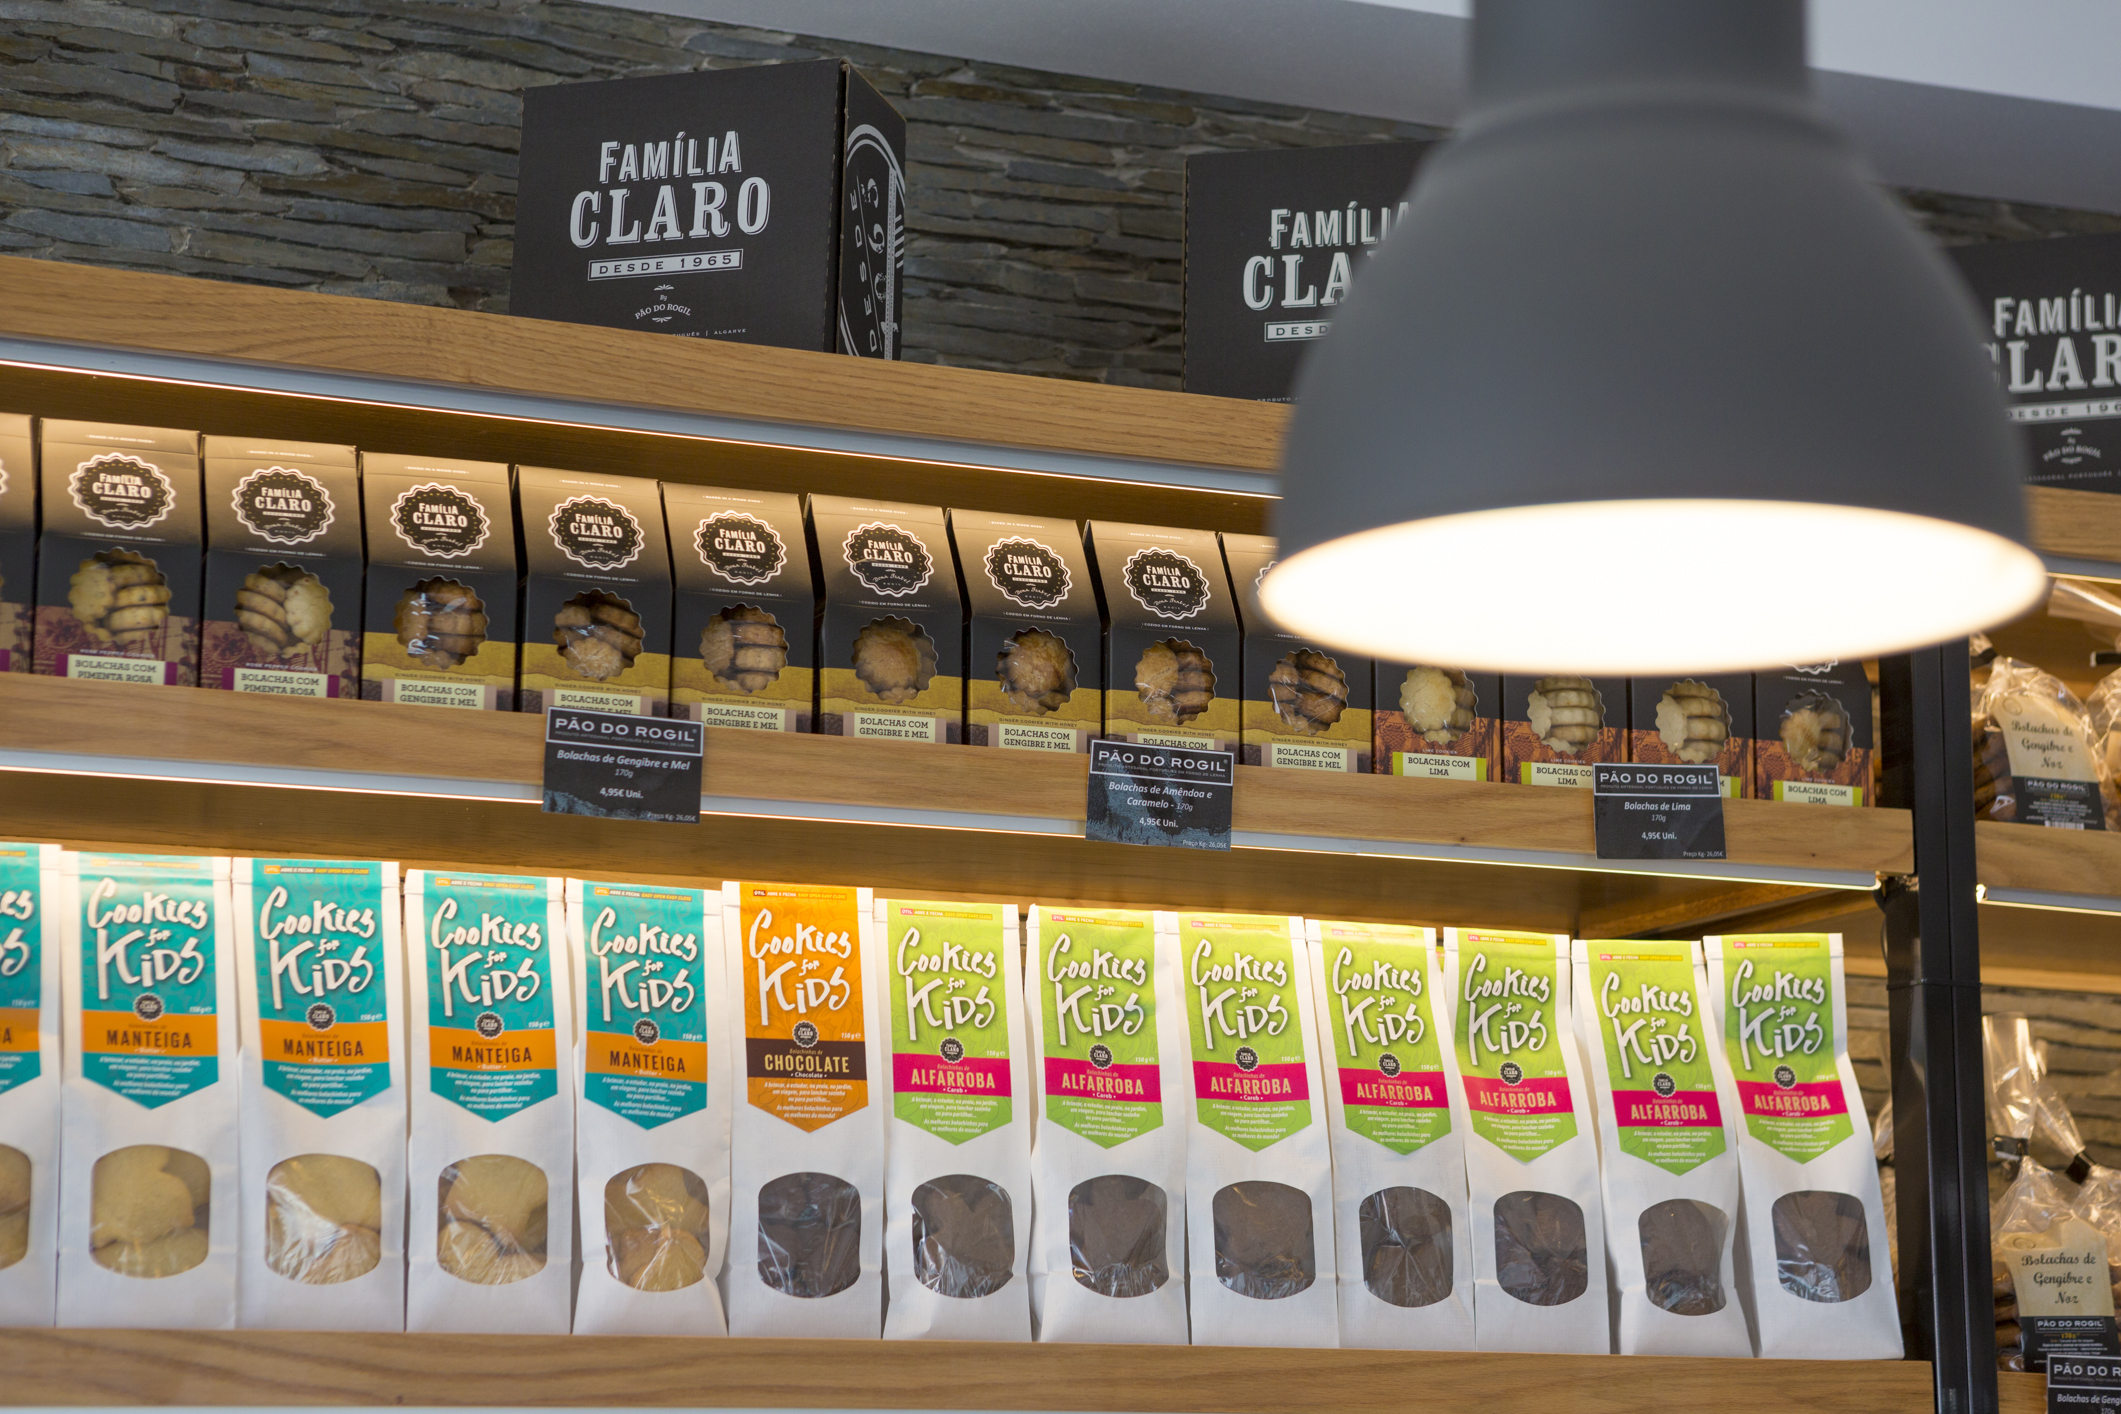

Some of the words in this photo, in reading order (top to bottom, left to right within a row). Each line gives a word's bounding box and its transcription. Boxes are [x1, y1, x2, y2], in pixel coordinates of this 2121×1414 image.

[599, 131, 743, 184] FAMÍLIA
[570, 176, 771, 248] CLARO
[599, 261, 664, 275] DESDE
[680, 255, 733, 269] 1965
[1243, 252, 1376, 310] CLA
[635, 307, 652, 320] PÃO
[653, 304, 665, 312] DO
[667, 304, 691, 316] ROGIL
[1994, 287, 2121, 338] FAMÍLI
[1275, 325, 1329, 337] DESD
[262, 487, 303, 499] FAMÍLIA
[255, 497, 311, 512] CLARO
[720, 528, 757, 540] FAMÍLIA
[714, 538, 766, 554] CLARO
[1007, 554, 1043, 566] FAMÍLIA
[1003, 563, 1052, 578] CLARO
[1146, 565, 1181, 577] FAMÍLIA
[1142, 574, 1190, 589] CLARO
[241, 673, 293, 685] BOLACHAS
[296, 677, 319, 686] COM
[243, 684, 287, 695] PIMENTA
[290, 687, 316, 696] ROSA
[555, 717, 595, 732] PÃO
[601, 723, 629, 735] DO
[635, 726, 695, 742] ROGIL
[1004, 728, 1049, 739] BOLACHAS
[1050, 730, 1070, 740] COM
[1004, 738, 1044, 749] GENGIBRE
[1053, 741, 1070, 750] MEL
[557, 750, 600, 762] Bolachas
[602, 754, 614, 763] de
[617, 756, 660, 768] Gengibre
[670, 761, 690, 770] Mel
[1099, 750, 1134, 763] PÃO
[1140, 755, 1165, 766] DO
[1171, 758, 1226, 772] ROGIL
[1407, 757, 1449, 768] BOLACHAS
[1451, 760, 1470, 768] COM
[614, 768, 634, 778] 170g
[1429, 768, 1449, 776] LIMA
[1600, 771, 1631, 783] PÃO
[1636, 774, 1658, 783] DO
[1663, 774, 1712, 784] ROGIL
[600, 787, 624, 797] 4,95€
[626, 790, 643, 799] Uni.
[1109, 782, 1148, 793] Bolachas
[1150, 786, 1160, 794] de
[1162, 787, 1204, 798] Amêndoa
[1788, 784, 1826, 796] BOLACHAS
[1829, 787, 1847, 797] COM
[1127, 797, 1168, 808] Caramelo
[1176, 803, 1193, 812] 170g
[1624, 802, 1658, 810] Bolachas
[1660, 802, 1669, 810] de
[1672, 802, 1691, 811] Lima
[1139, 817, 1161, 827] 4,95€
[1163, 820, 1178, 828] Uni.
[1642, 832, 1661, 840] 4,95€
[144, 928, 171, 947] for
[315, 938, 340, 957] for
[484, 950, 507, 968] for
[642, 959, 664, 976] for
[799, 959, 820, 976] for
[946, 977, 965, 993] for
[1095, 984, 1114, 1001] for
[1239, 987, 1258, 1003] for
[1378, 995, 1395, 1011] for
[1504, 1002, 1522, 1019] for
[1777, 1006, 1797, 1022] for
[1650, 1017, 1667, 1032] for
[106, 1030, 192, 1048] MANTEIGA
[283, 1038, 364, 1056] MANTEIGA
[452, 1046, 532, 1063] MANTEIGA
[610, 1050, 686, 1073] MANTEIGA
[764, 1054, 850, 1073] CHOCOLATE
[911, 1068, 995, 1089] ALFARROBA
[1062, 1073, 1144, 1095] ALFARROBA
[1211, 1077, 1291, 1095] ALFARROBA
[1357, 1083, 1433, 1101] ALFARROBA
[1480, 1091, 1556, 1107] ALFARROBA
[1754, 1095, 1830, 1111] ALFARROBA
[1631, 1104, 1708, 1120] ALFARROBA
[2021, 1252, 2079, 1266] Bolachas
[2083, 1252, 2096, 1265] de
[2033, 1272, 2084, 1287] Gengibre
[2086, 1276, 2092, 1284] e
[2054, 1292, 2079, 1304] Noz
[2037, 1319, 2056, 1328] PÃO
[2074, 1319, 2103, 1327] ROGIL
[2054, 1363, 2083, 1375] PÃO
[2087, 1365, 2108, 1376] DO
[2057, 1394, 2089, 1403] Bolachas
[2091, 1395, 2100, 1403] de
[2102, 1396, 2121, 1406] Geng
